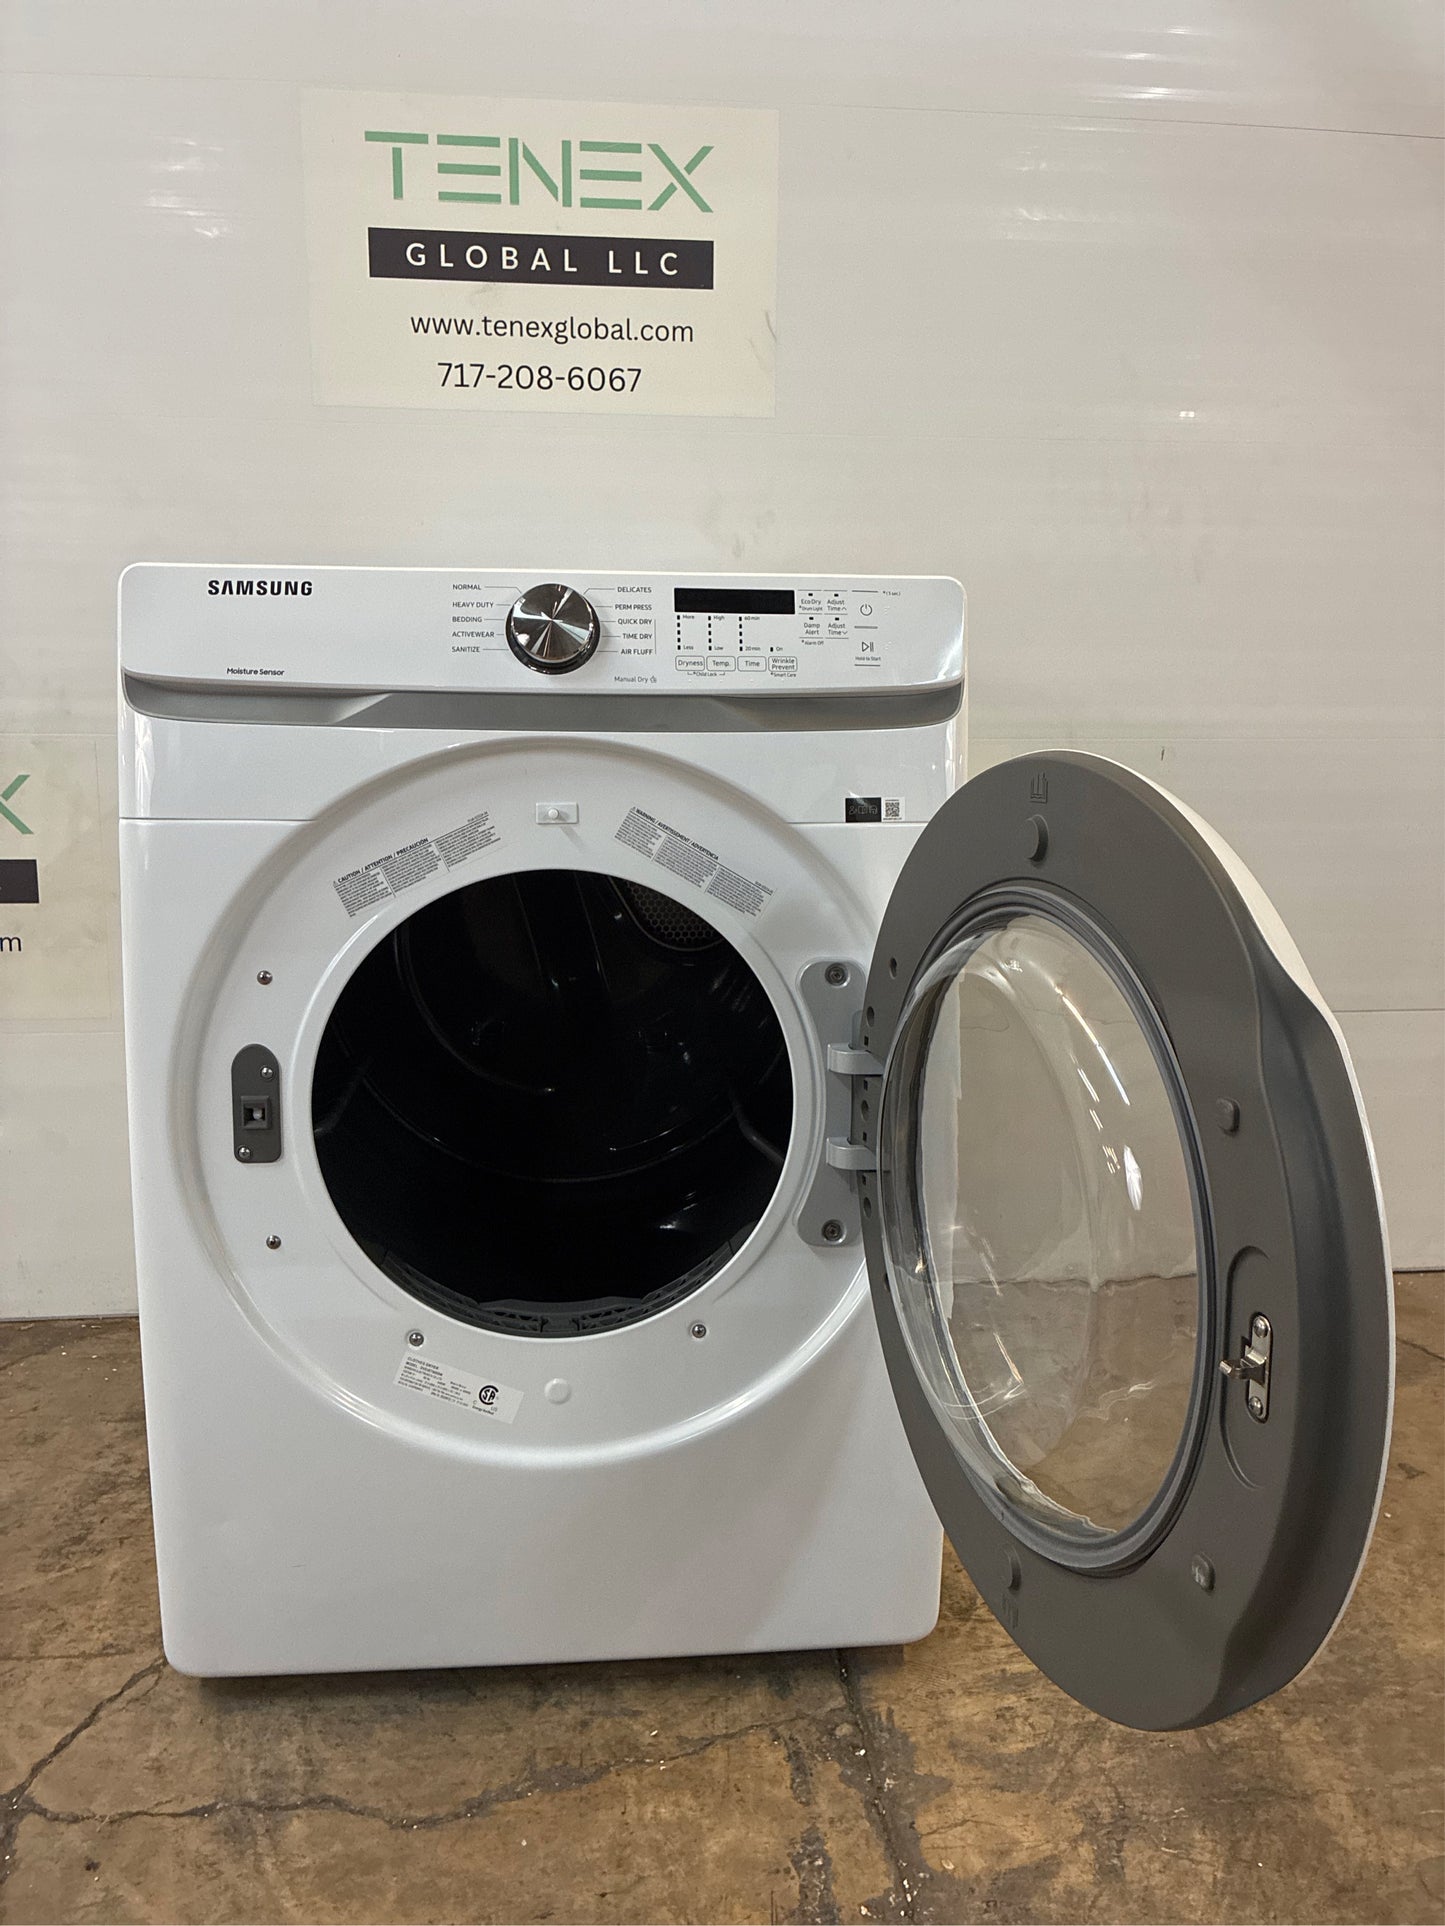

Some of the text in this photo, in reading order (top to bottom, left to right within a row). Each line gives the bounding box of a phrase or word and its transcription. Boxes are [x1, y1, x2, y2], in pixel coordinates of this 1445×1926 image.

[364, 130, 715, 213] TENEX
[405, 242, 679, 276] GLOBAL LLC
[410, 315, 694, 344] www.tenexglobal.com
[437, 362, 642, 392] 717-208-6067
[207, 580, 313, 596] SAMSUNG
[226, 667, 285, 676] Moisture Sensor
[638, 676, 648, 684] Dry
[337, 869, 361, 883] CAUTION
[364, 854, 393, 871] ATTENTION
